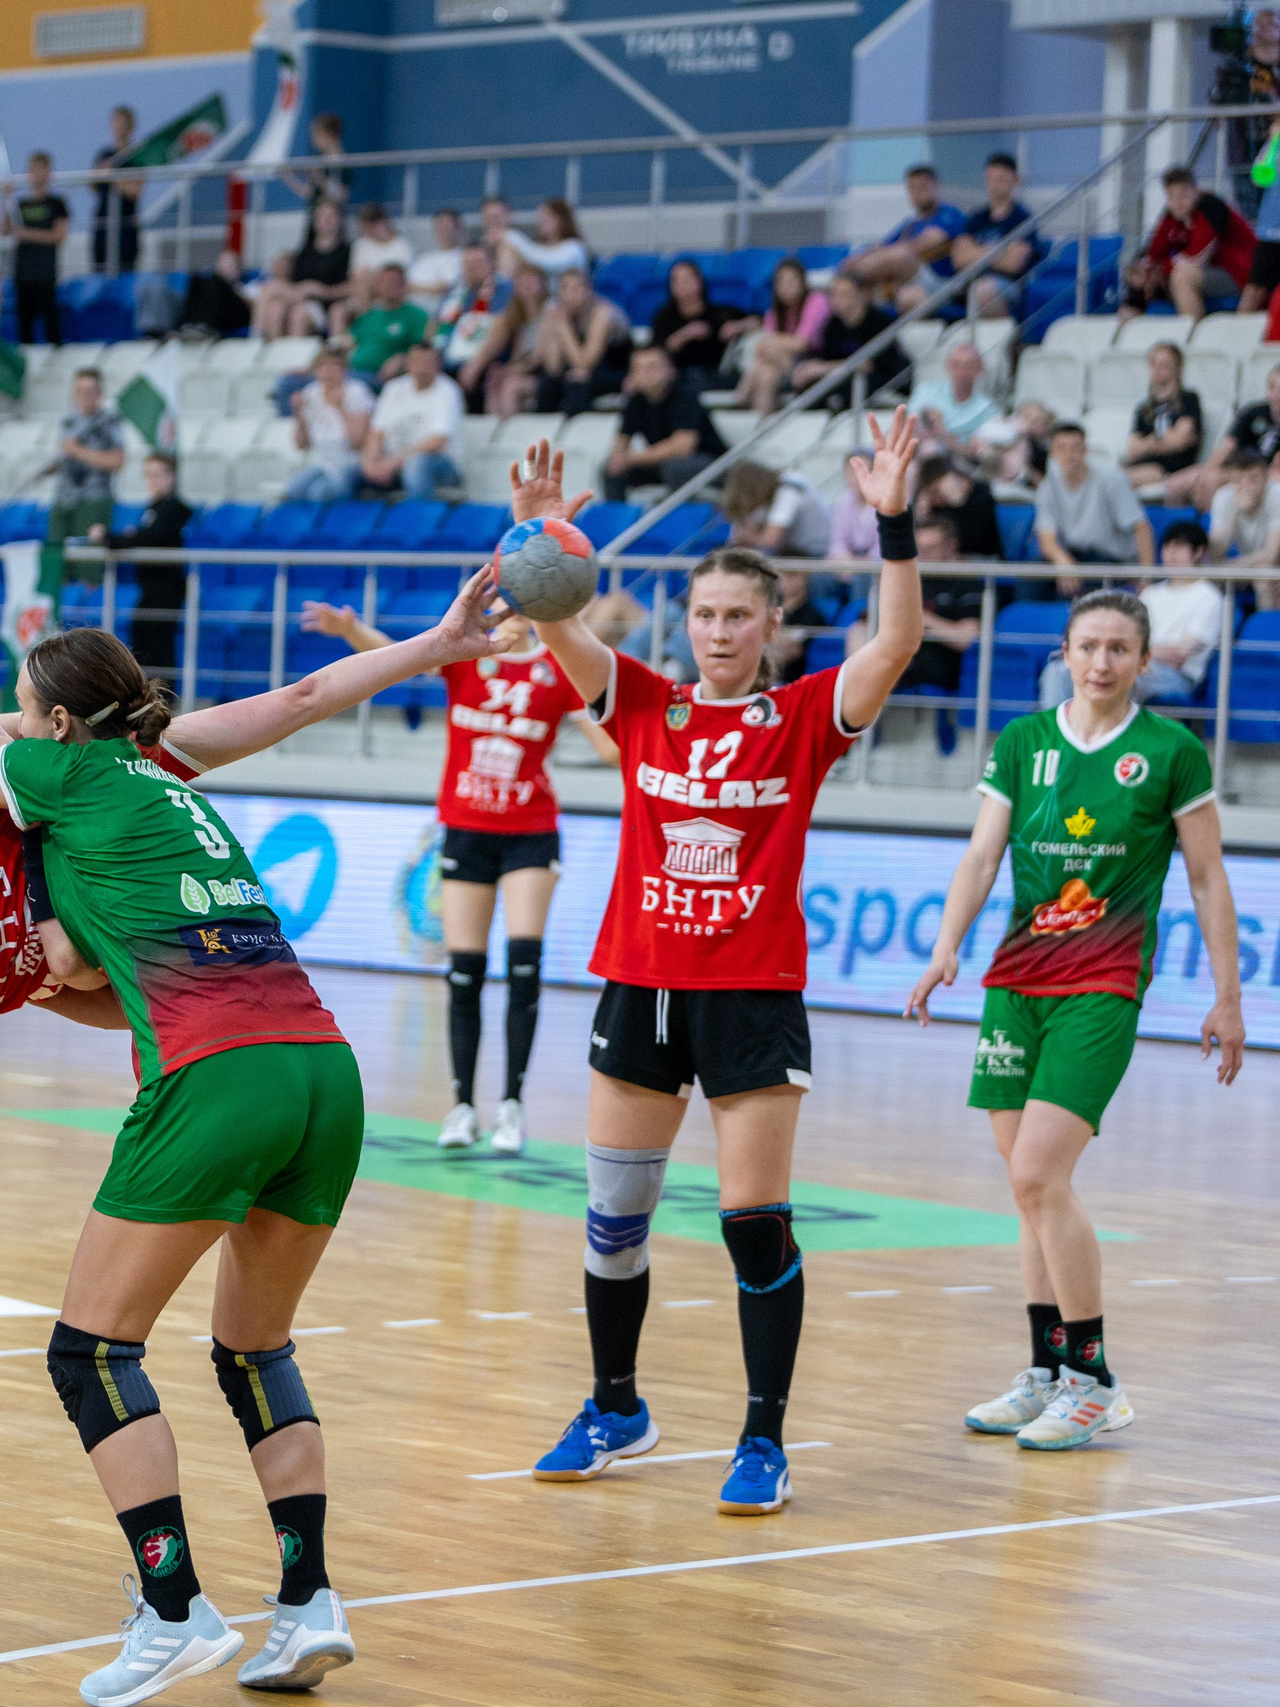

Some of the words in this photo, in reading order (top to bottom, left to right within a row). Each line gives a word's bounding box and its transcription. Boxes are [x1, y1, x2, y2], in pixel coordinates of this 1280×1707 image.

[479, 678, 534, 715] 34
[451, 703, 549, 742] BELAZ
[637, 762, 791, 808] BELAZ
[1032, 749, 1061, 786] 10
[165, 788, 231, 859] 3
[1031, 841, 1126, 858] ГОМЕЛЬСКИЙ
[641, 876, 766, 921] БНТУ
[674, 922, 715, 936] 1920
